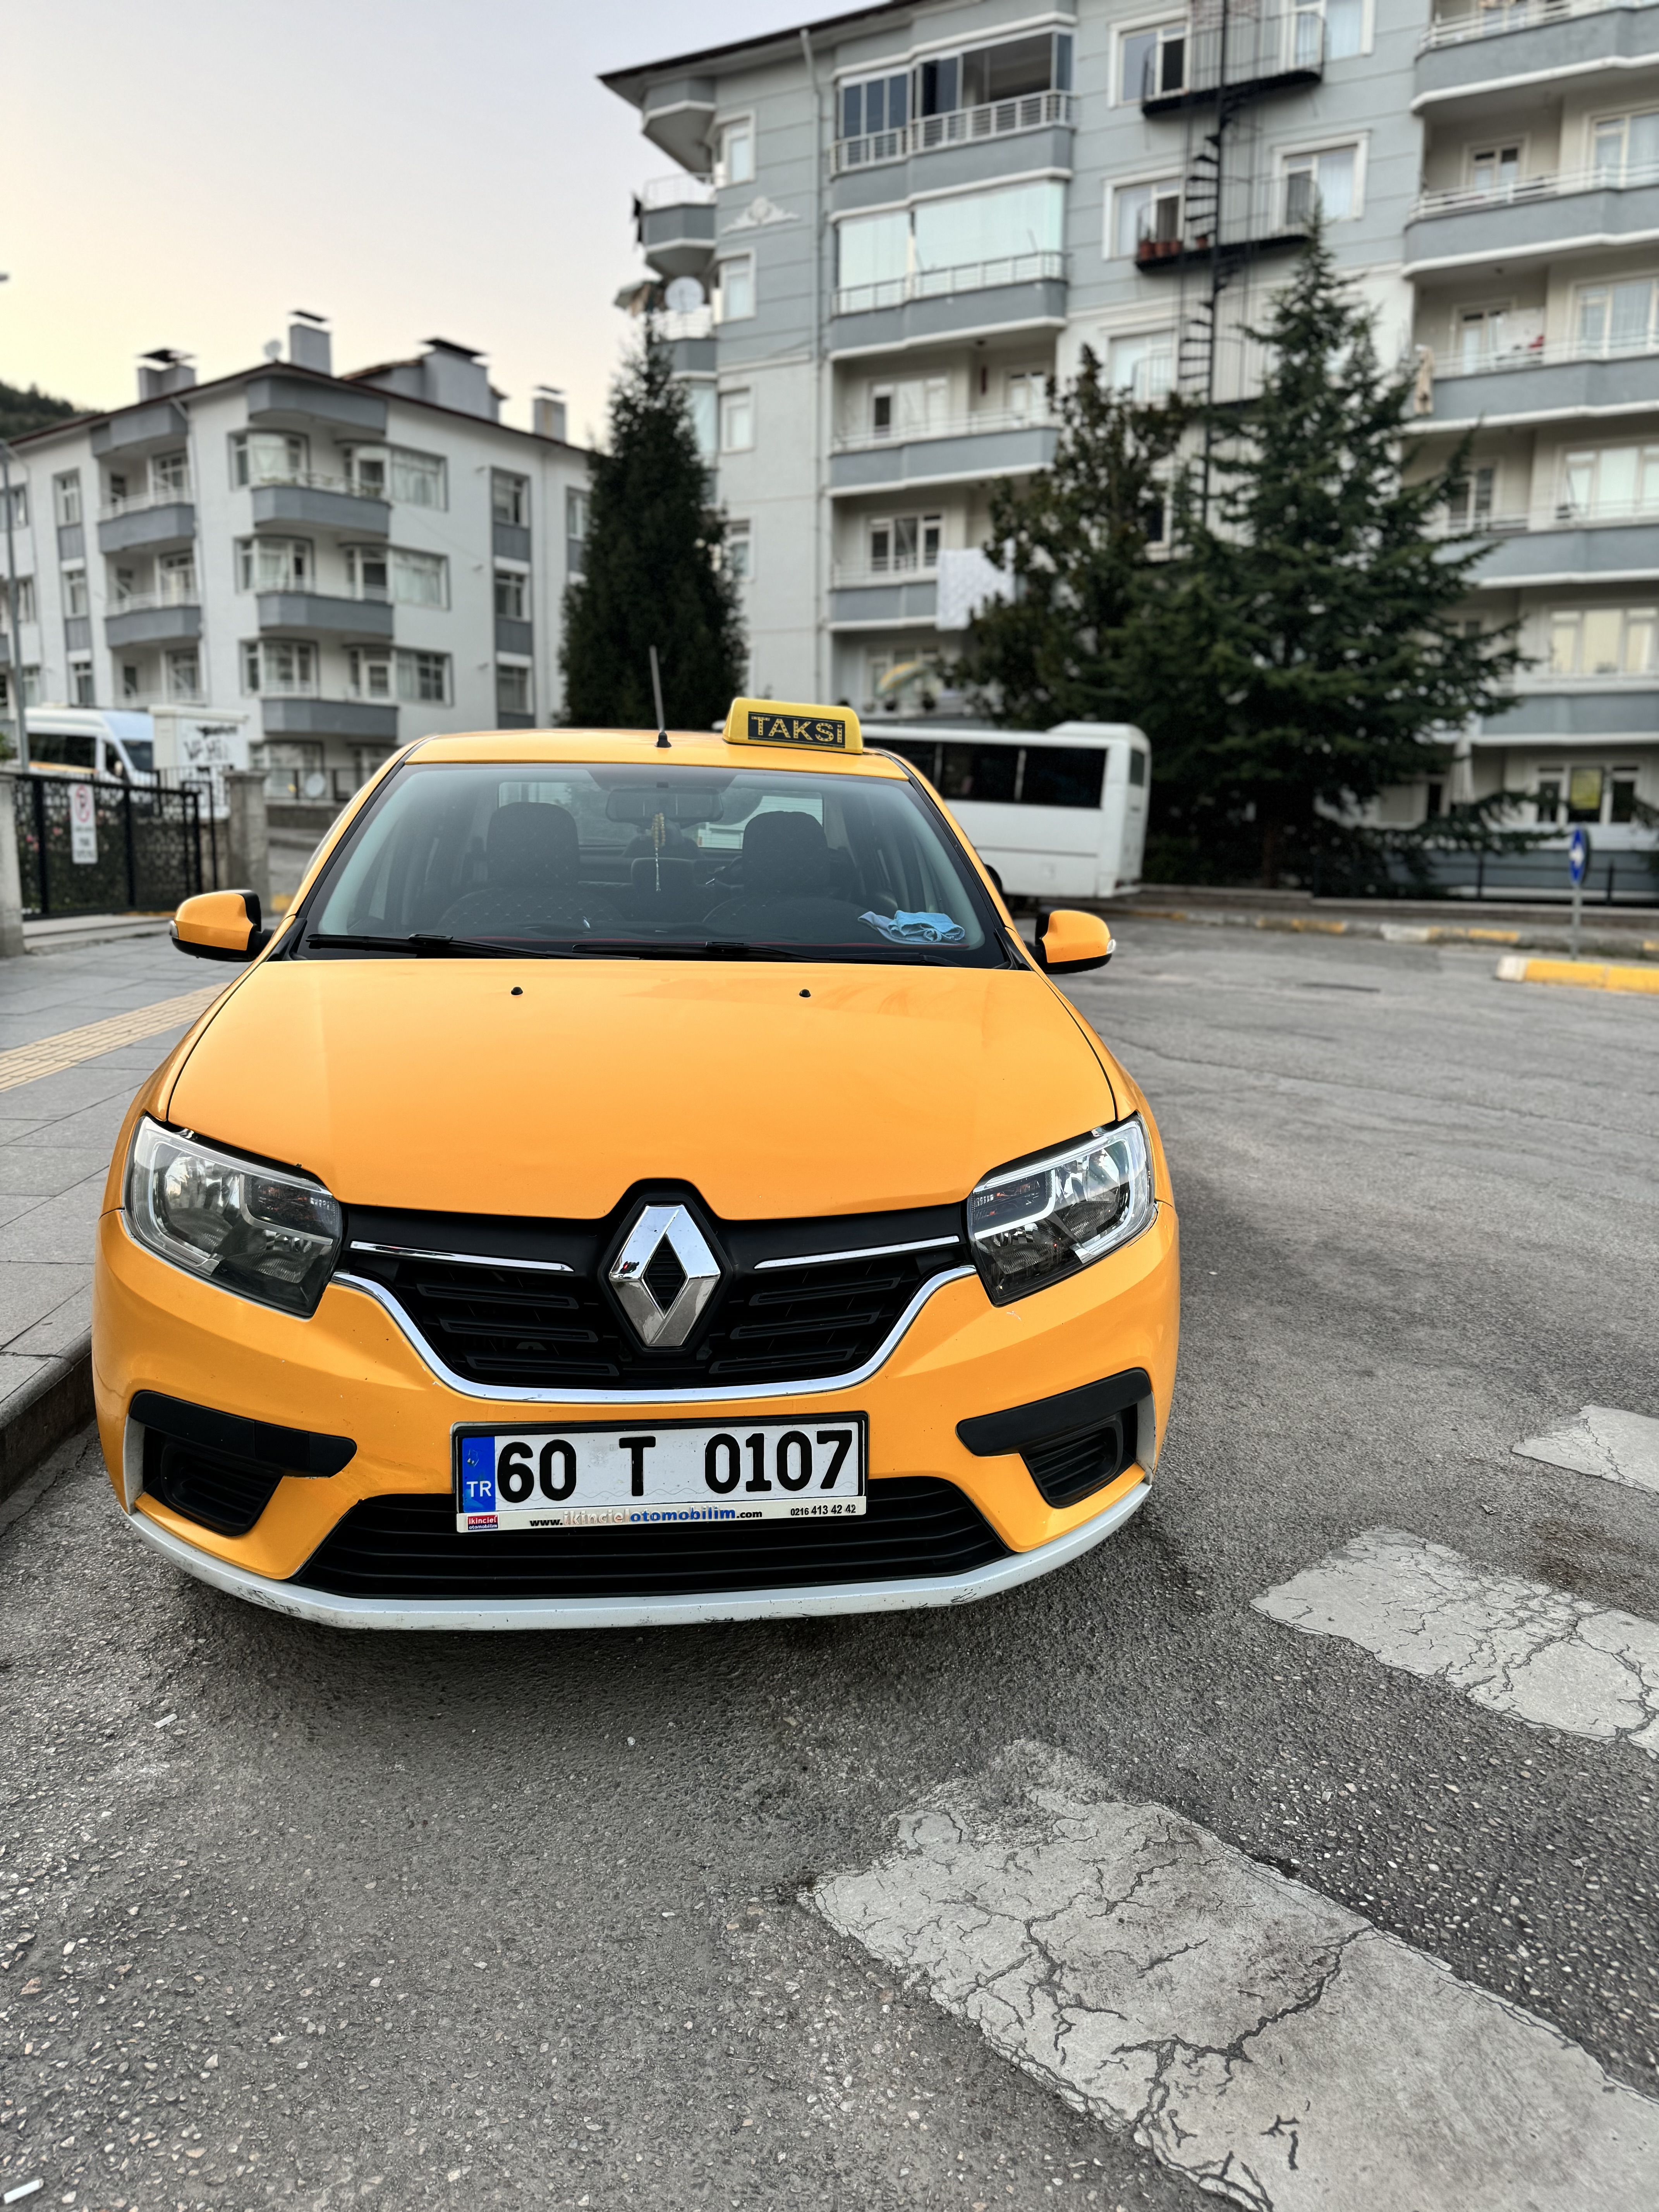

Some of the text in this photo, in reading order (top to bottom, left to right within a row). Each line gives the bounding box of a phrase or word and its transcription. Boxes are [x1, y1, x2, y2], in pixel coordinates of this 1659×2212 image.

[497, 1430, 852, 1503] 60 T 0107
[466, 1480, 492, 1498] TR
[790, 1507, 809, 1516] 0216
[811, 1505, 828, 1515] 413
[831, 1505, 842, 1514] 42
